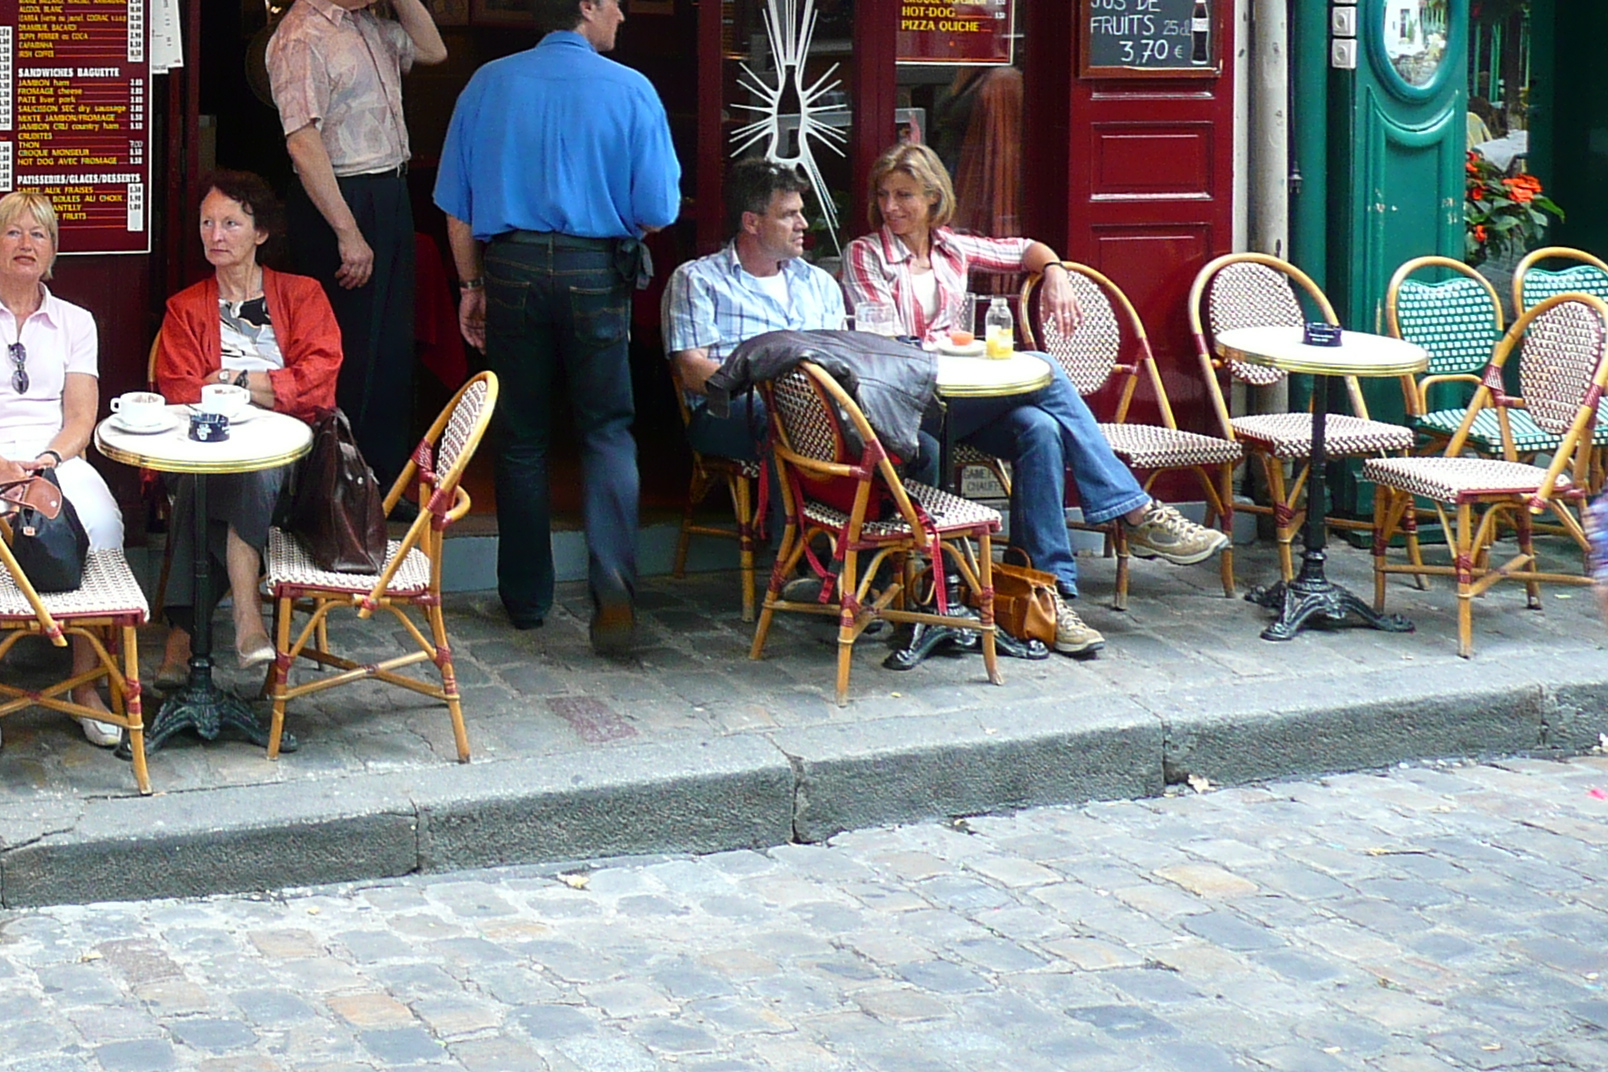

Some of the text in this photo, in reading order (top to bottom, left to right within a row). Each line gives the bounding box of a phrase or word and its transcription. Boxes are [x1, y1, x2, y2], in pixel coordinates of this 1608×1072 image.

[902, 6, 956, 17] HOT-DOG
[902, 20, 979, 32] PIZZA QUICHE
[1163, 20, 1191, 36] 25cl
[1119, 39, 1183, 65] 3,70 €
[18, 68, 119, 77] SANDWICHES BAGUETTE
